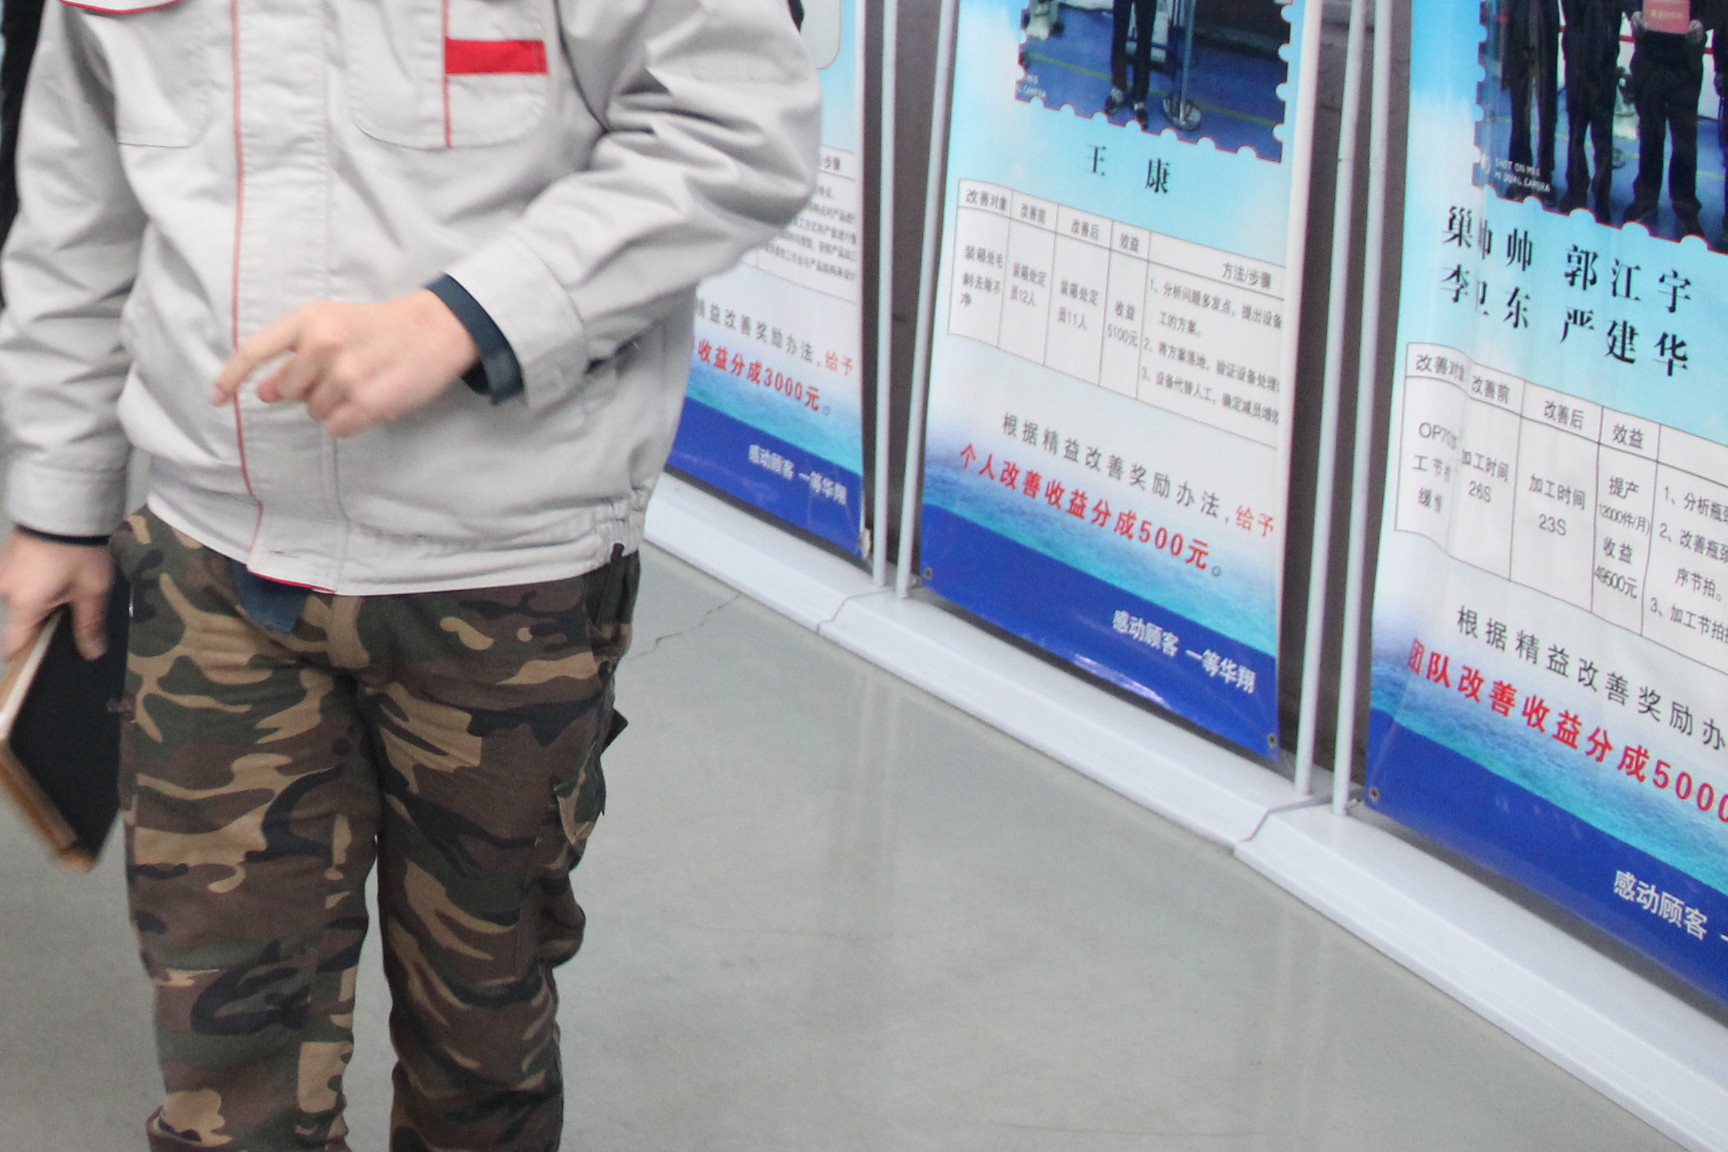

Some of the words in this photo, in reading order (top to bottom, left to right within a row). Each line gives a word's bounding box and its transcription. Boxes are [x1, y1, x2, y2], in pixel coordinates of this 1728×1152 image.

[1543, 400, 1586, 430] 改善后
[1612, 422, 1645, 450] 效益
[1528, 473, 1587, 511] 加工时间
[1608, 475, 1640, 500] 提产
[1538, 512, 1568, 537] 23S
[1602, 536, 1633, 565] 收益
[1456, 604, 1727, 752] 根据精益改善奖励办
[1612, 868, 1709, 941] 感动顾客
